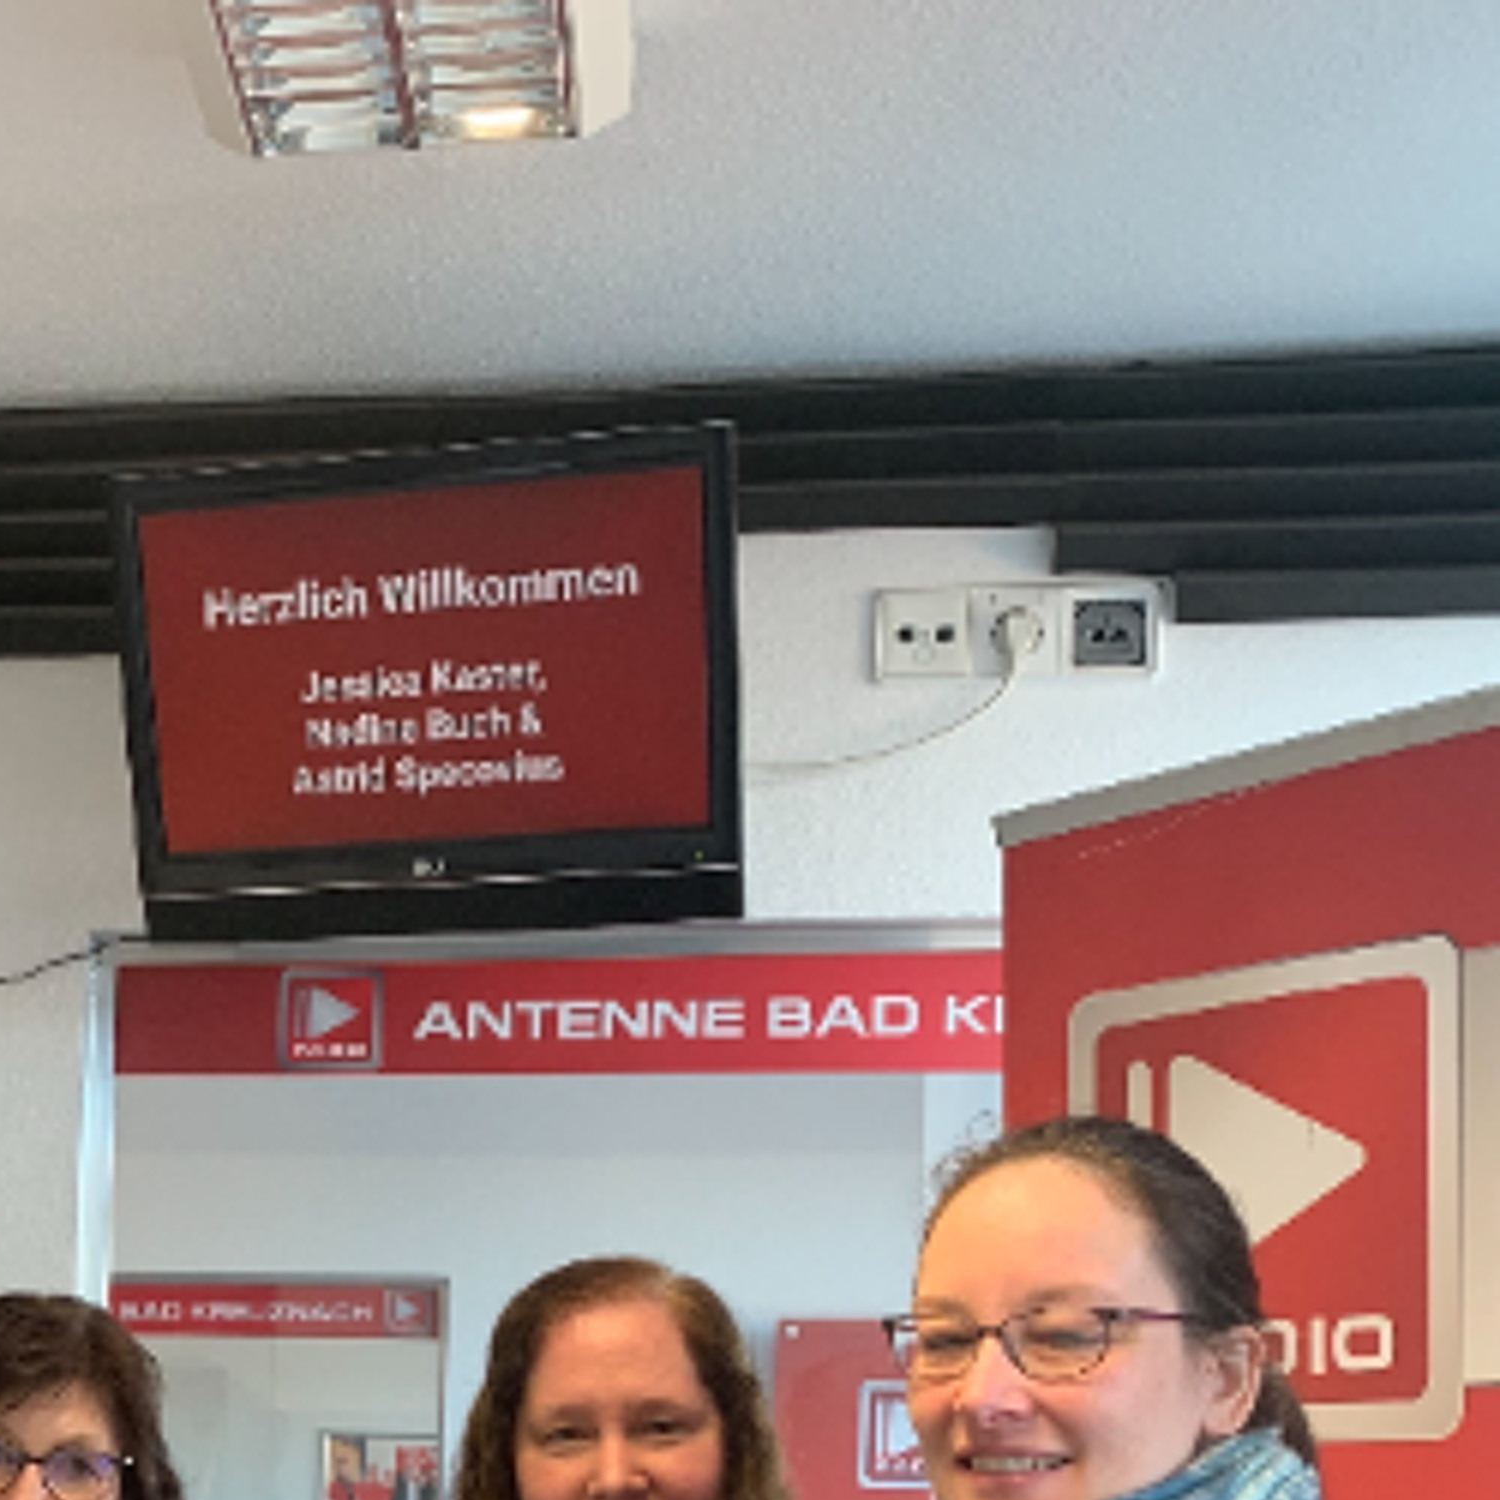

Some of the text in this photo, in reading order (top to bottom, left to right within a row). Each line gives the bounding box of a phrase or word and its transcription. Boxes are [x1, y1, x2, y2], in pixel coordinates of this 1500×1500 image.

[203, 562, 638, 630] Herzlich Willkommen
[426, 705, 511, 740] Buch
[519, 702, 542, 734] &
[293, 756, 385, 794] Astrid
[412, 1000, 745, 1041] ANTENNE
[766, 995, 920, 1038] BAD
[1262, 1314, 1393, 1376] DIO
